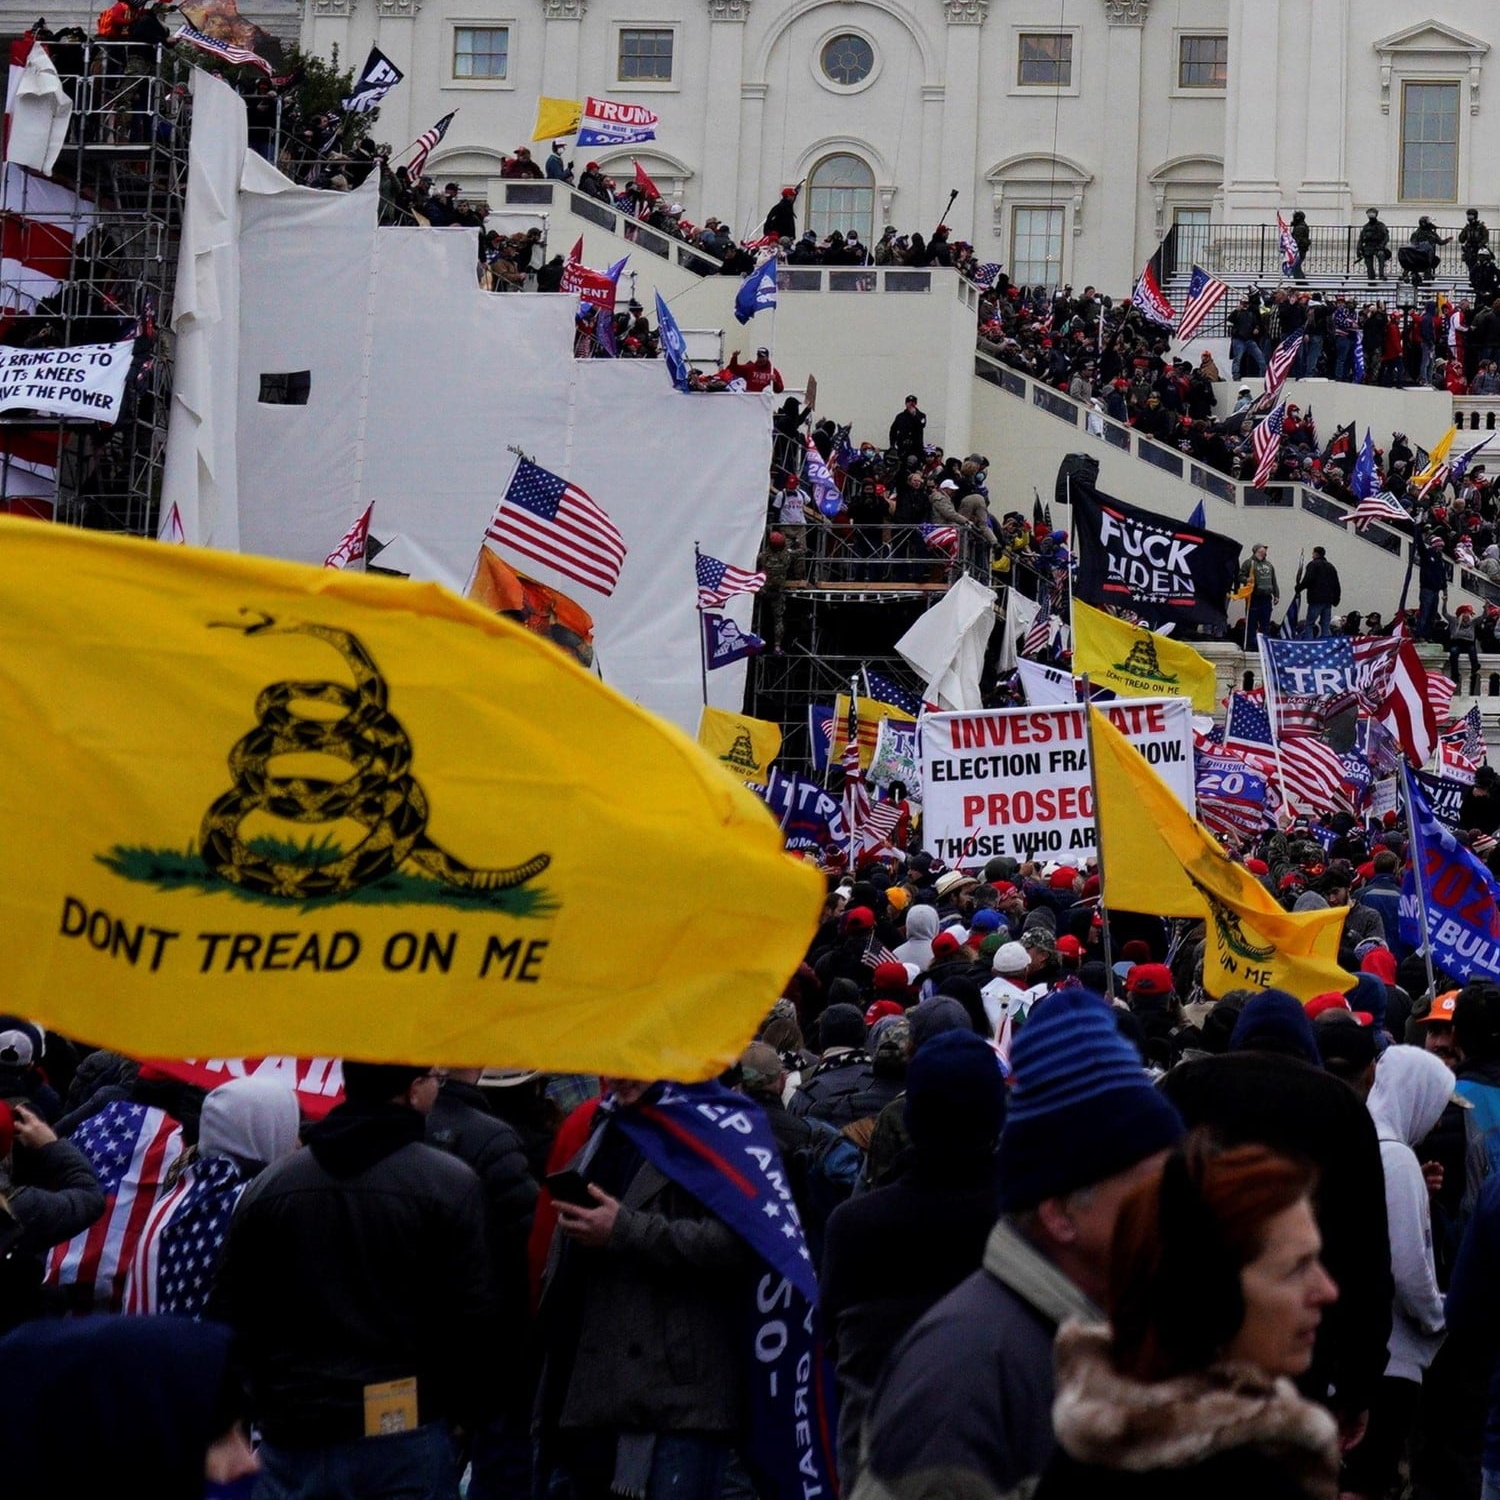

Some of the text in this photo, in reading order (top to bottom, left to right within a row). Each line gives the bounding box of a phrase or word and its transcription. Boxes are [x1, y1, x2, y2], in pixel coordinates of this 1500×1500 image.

[561, 280, 609, 299] SIDENT
[56, 352, 82, 364] DC
[88, 353, 113, 367] TO
[34, 367, 86, 383] KNEES
[26, 385, 113, 409] THE POWER
[1100, 510, 1199, 575] FUCK
[1125, 675, 1150, 690] TREAD
[1152, 684, 1164, 693] ON
[1167, 686, 1180, 695] ME
[950, 704, 1166, 749] INVESTIATE
[932, 751, 1041, 782] ELECTION
[1049, 749, 1087, 773] FRA
[963, 786, 1095, 828] PROSEC
[935, 826, 1097, 859] THOSE WHO AR
[60, 896, 550, 983] DONT TREAD ON ME
[1245, 968, 1274, 988] ME
